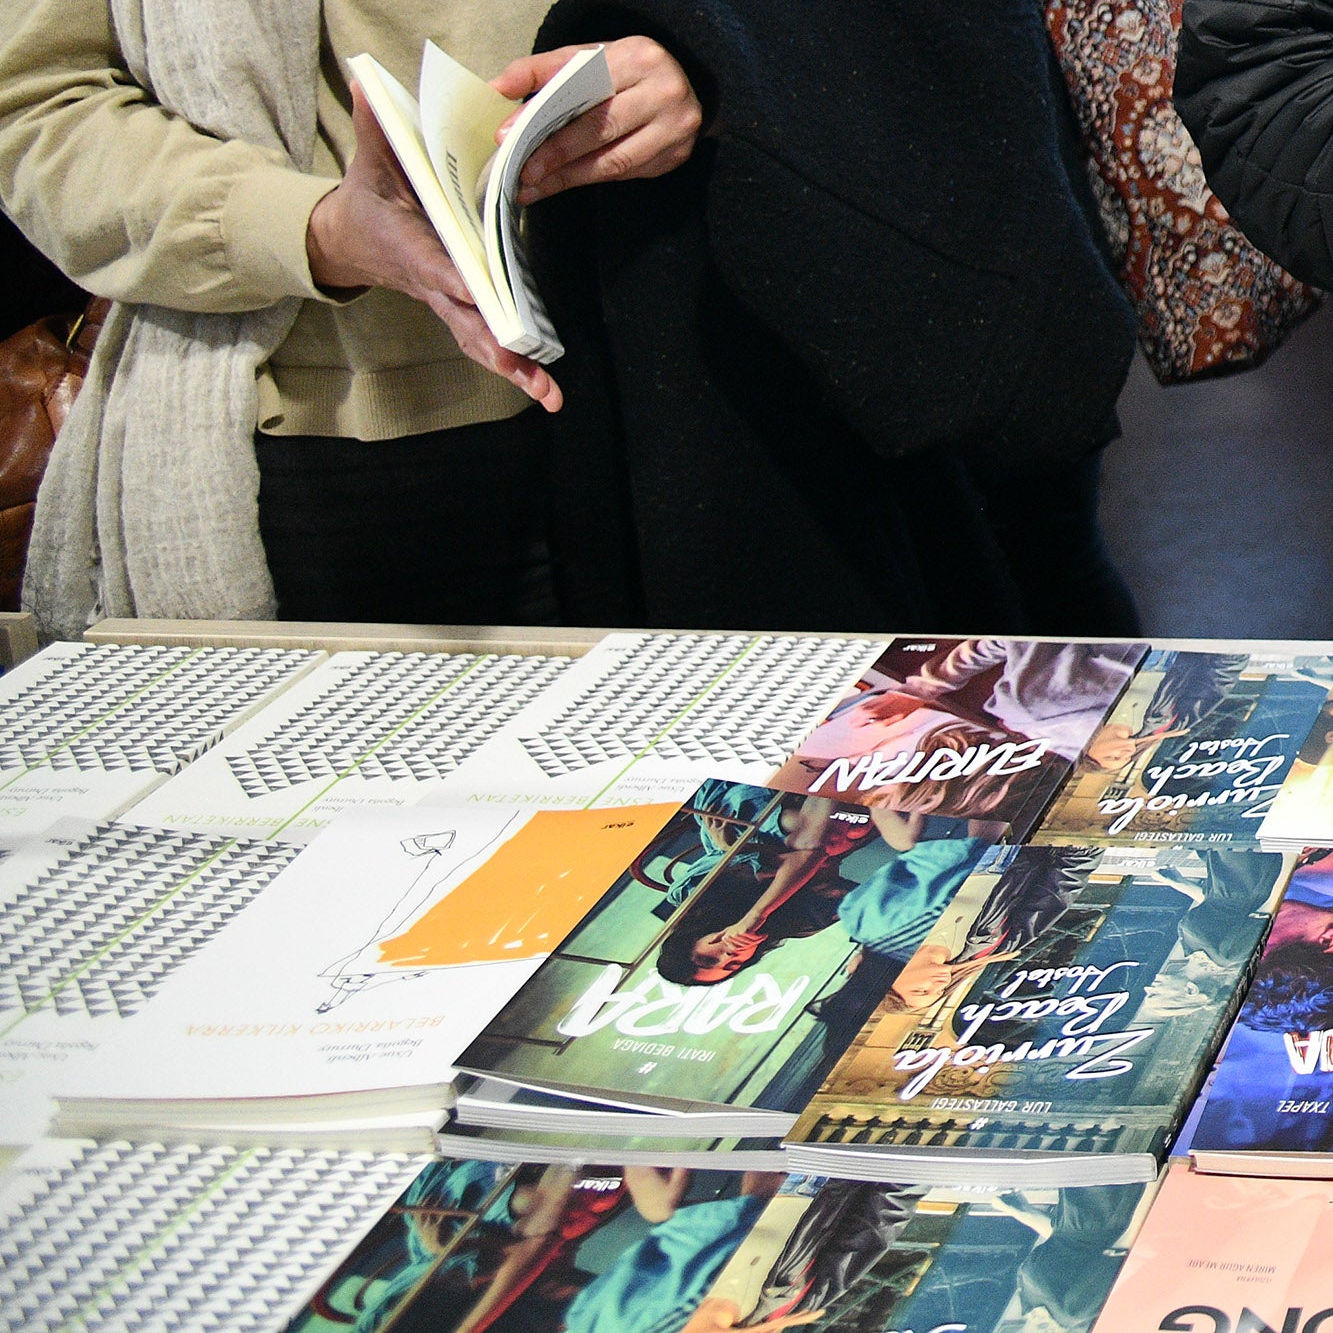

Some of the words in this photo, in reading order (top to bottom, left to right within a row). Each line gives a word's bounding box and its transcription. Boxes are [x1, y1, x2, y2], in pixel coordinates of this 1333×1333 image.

[1180, 733, 1289, 761] Hostel
[808, 737, 1051, 794] EURITAN
[1146, 754, 1284, 793] Beach
[1098, 785, 1285, 834] Zurriola
[162, 813, 283, 828] BERRIKETAN
[830, 813, 869, 826] elkar
[1134, 831, 1204, 842] GALLASTEGI
[1208, 832, 1232, 842] LUR
[1000, 960, 1140, 999] Hostel
[556, 963, 809, 1039] RARA
[957, 989, 1130, 1045] Beach
[612, 1039, 676, 1057] BEDIAGA
[679, 1046, 716, 1063] IRATI
[893, 1027, 1155, 1100] Zurriola
[932, 1098, 1017, 1113] GALLASTEGI
[1025, 1100, 1052, 1114] LUR
[1277, 1100, 1330, 1113] TXAPEL
[572, 1177, 623, 1192] elkar
